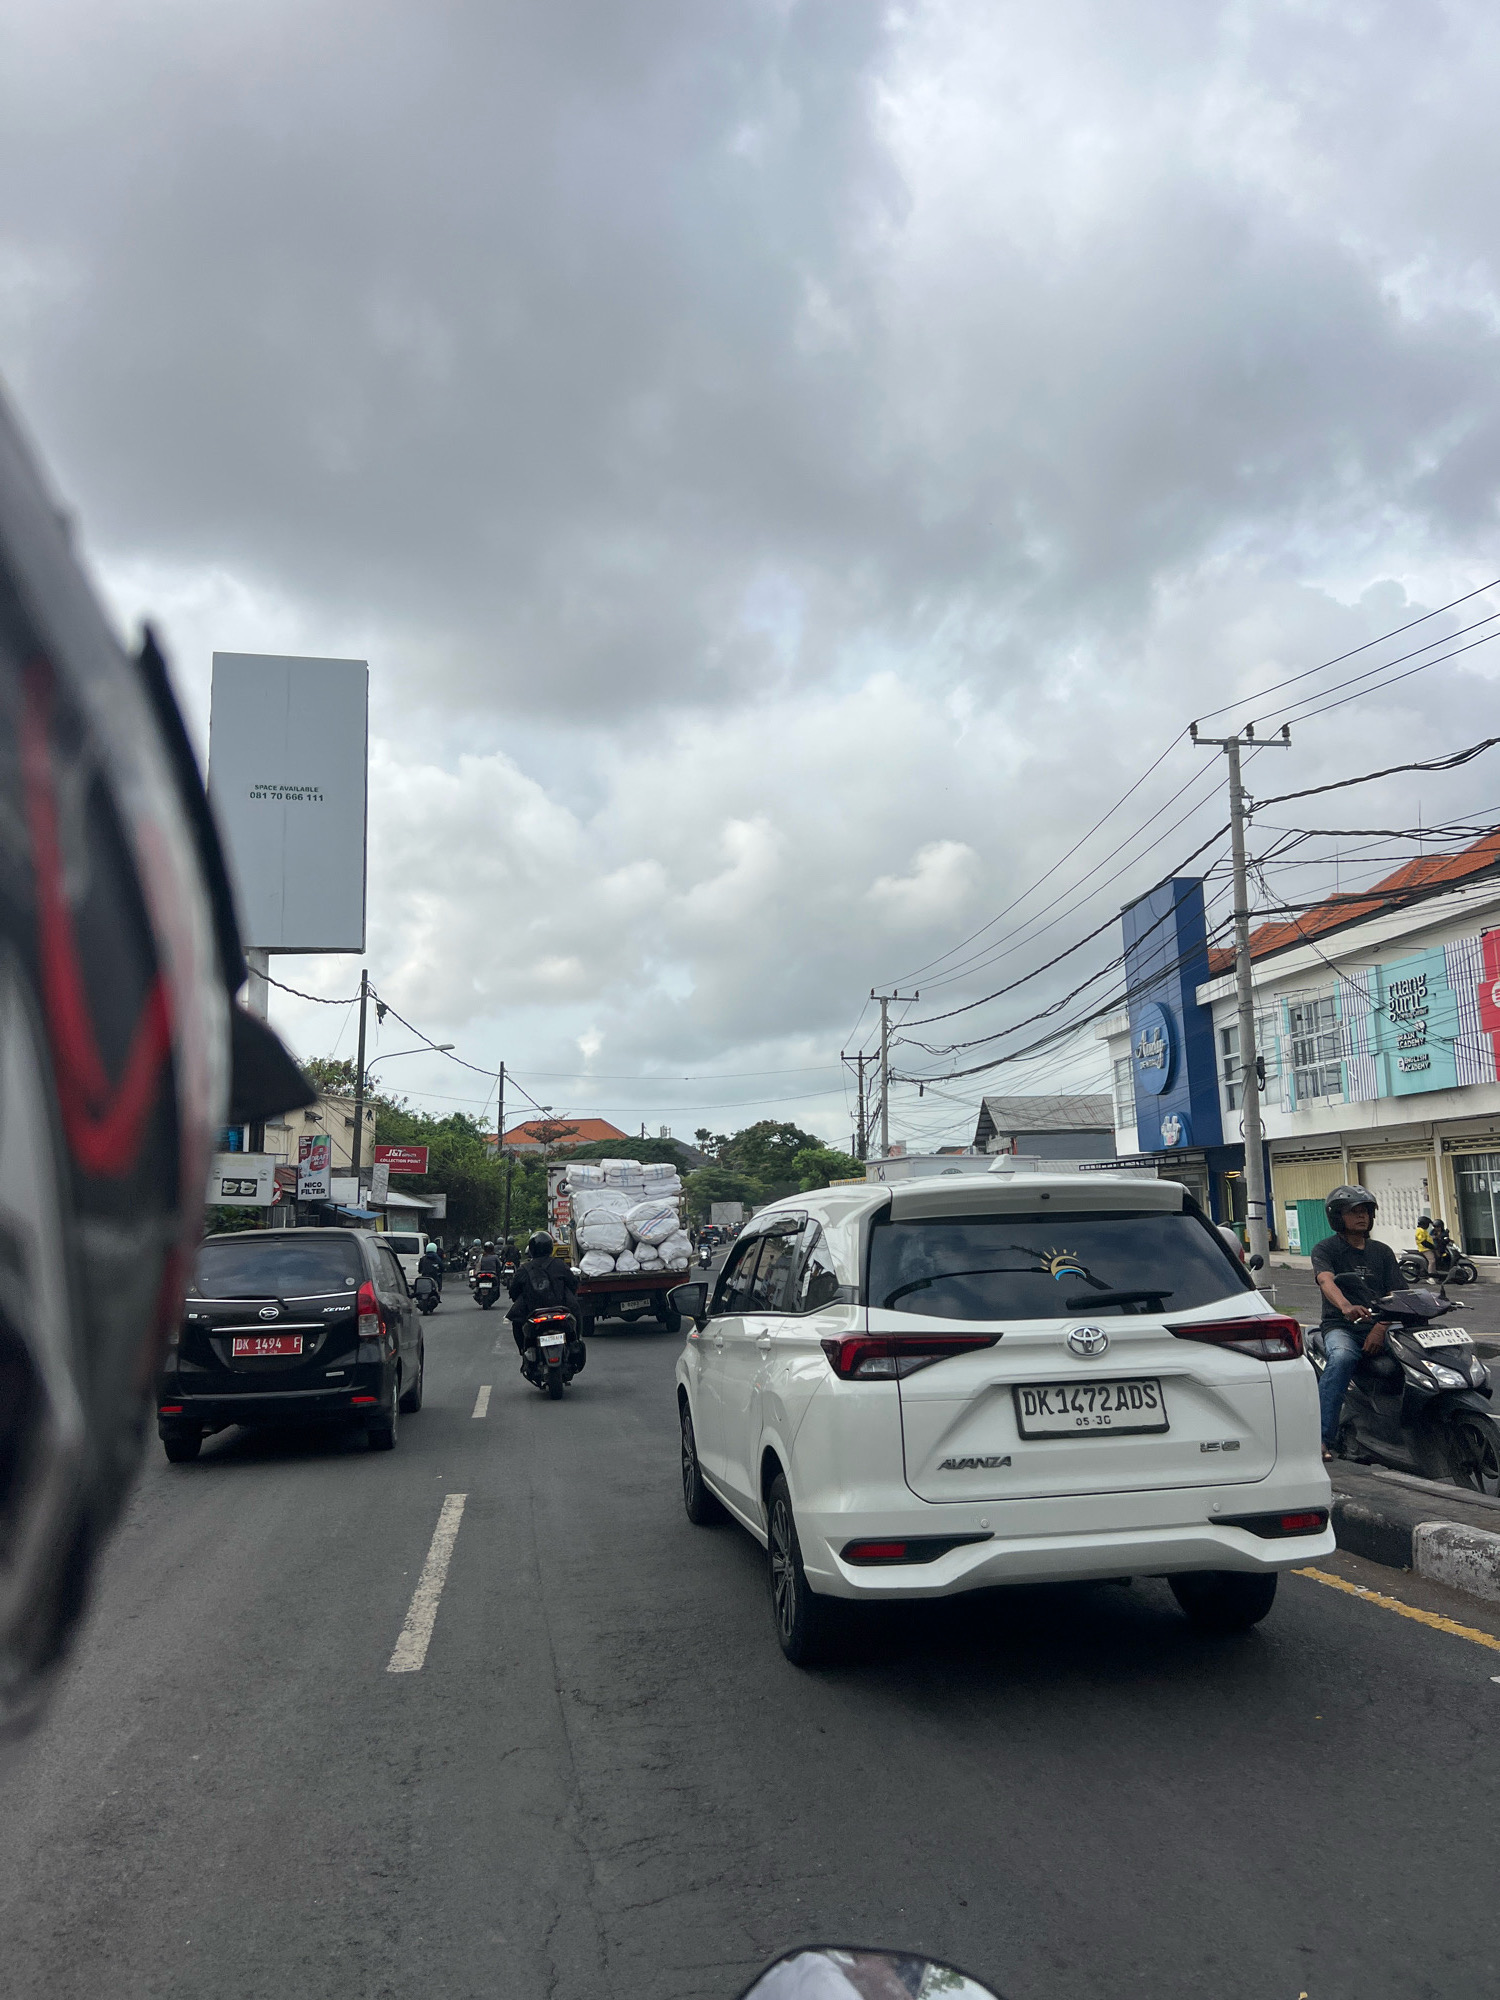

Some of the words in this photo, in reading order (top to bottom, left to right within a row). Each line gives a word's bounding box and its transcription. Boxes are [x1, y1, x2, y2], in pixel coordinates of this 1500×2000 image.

[279, 785, 319, 793] AVAILABLE
[249, 791, 267, 799] 081
[270, 792, 283, 800] 70
[285, 793, 304, 801] 666
[306, 794, 324, 802] 111
[1389, 973, 1427, 998] ruang
[1389, 993, 1421, 1022] guru
[1404, 1054, 1429, 1063] ENGLISH
[1404, 1062, 1431, 1072] ACADEMY
[385, 1149, 403, 1157] J&T
[236, 1338, 249, 1350] DK
[255, 1337, 282, 1350] 1494
[293, 1336, 301, 1349] F
[936, 1455, 1012, 1471] AVANZA
